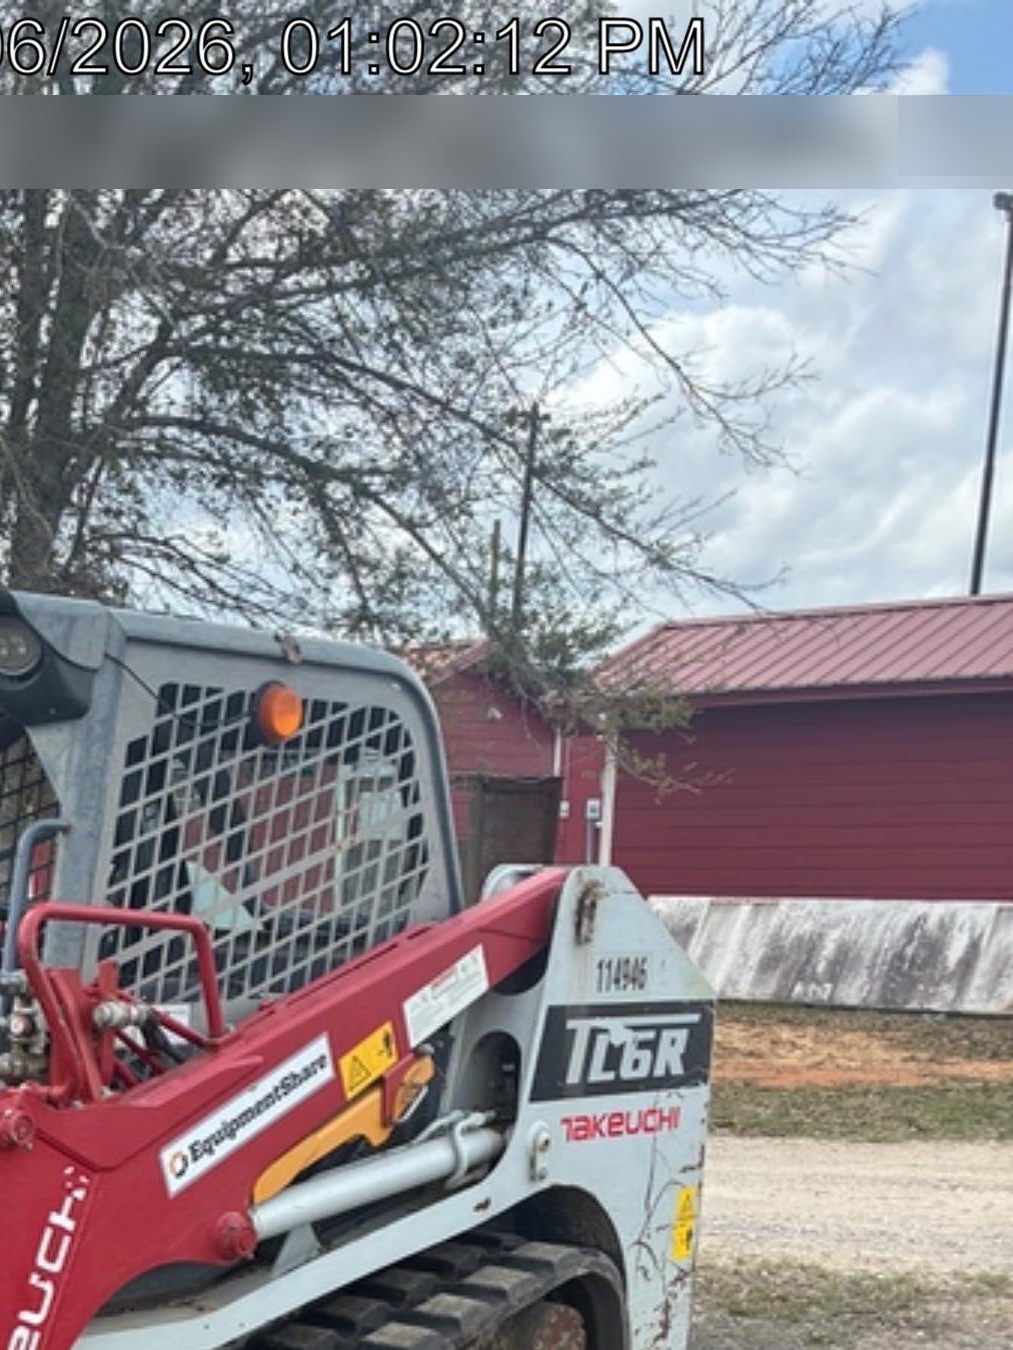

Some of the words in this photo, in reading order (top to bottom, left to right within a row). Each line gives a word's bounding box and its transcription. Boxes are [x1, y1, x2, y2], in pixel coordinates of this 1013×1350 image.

[596, 956, 649, 993] 114946
[188, 1054, 328, 1163] EquipmentShare
[560, 1105, 682, 1142] TAKEUCHI
